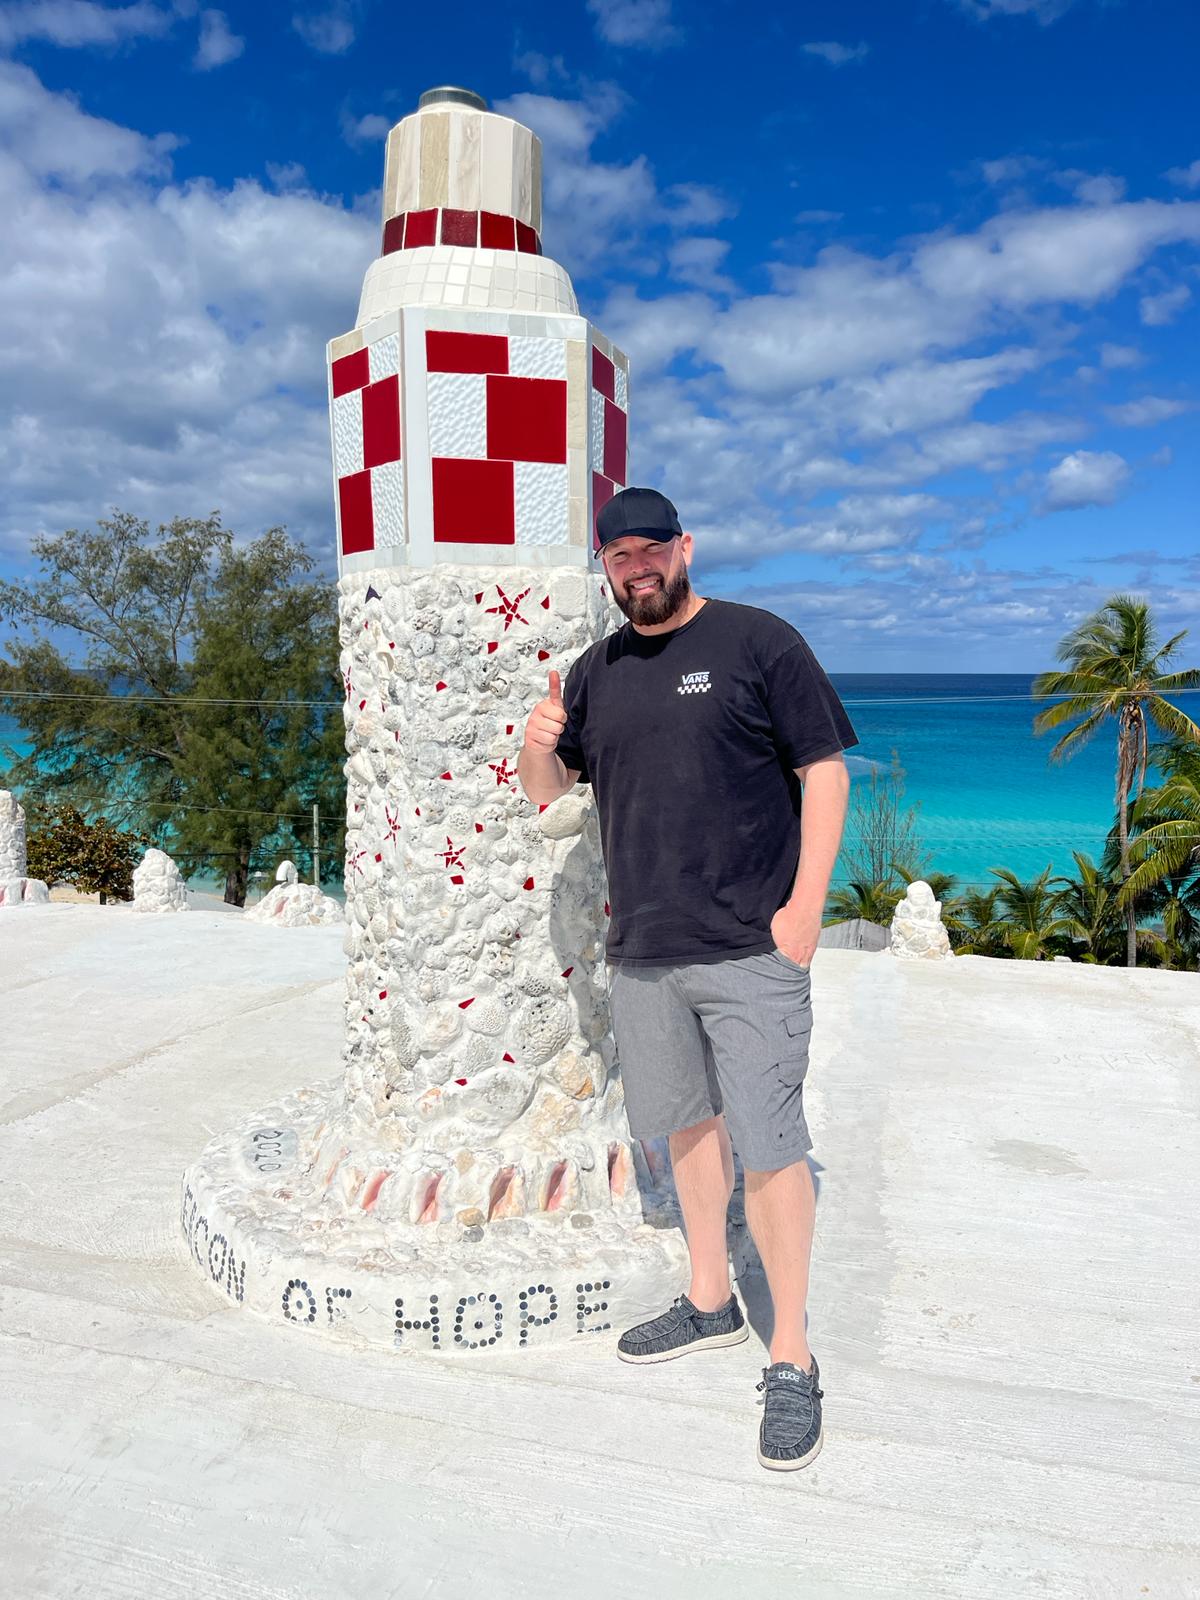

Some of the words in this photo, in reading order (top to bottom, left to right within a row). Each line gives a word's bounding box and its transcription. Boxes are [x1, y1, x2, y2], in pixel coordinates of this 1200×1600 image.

[681, 671, 710, 685] VANS
[253, 1131, 284, 1172] 2020
[281, 1278, 352, 1326] OF
[394, 1280, 611, 1350] HOPE
